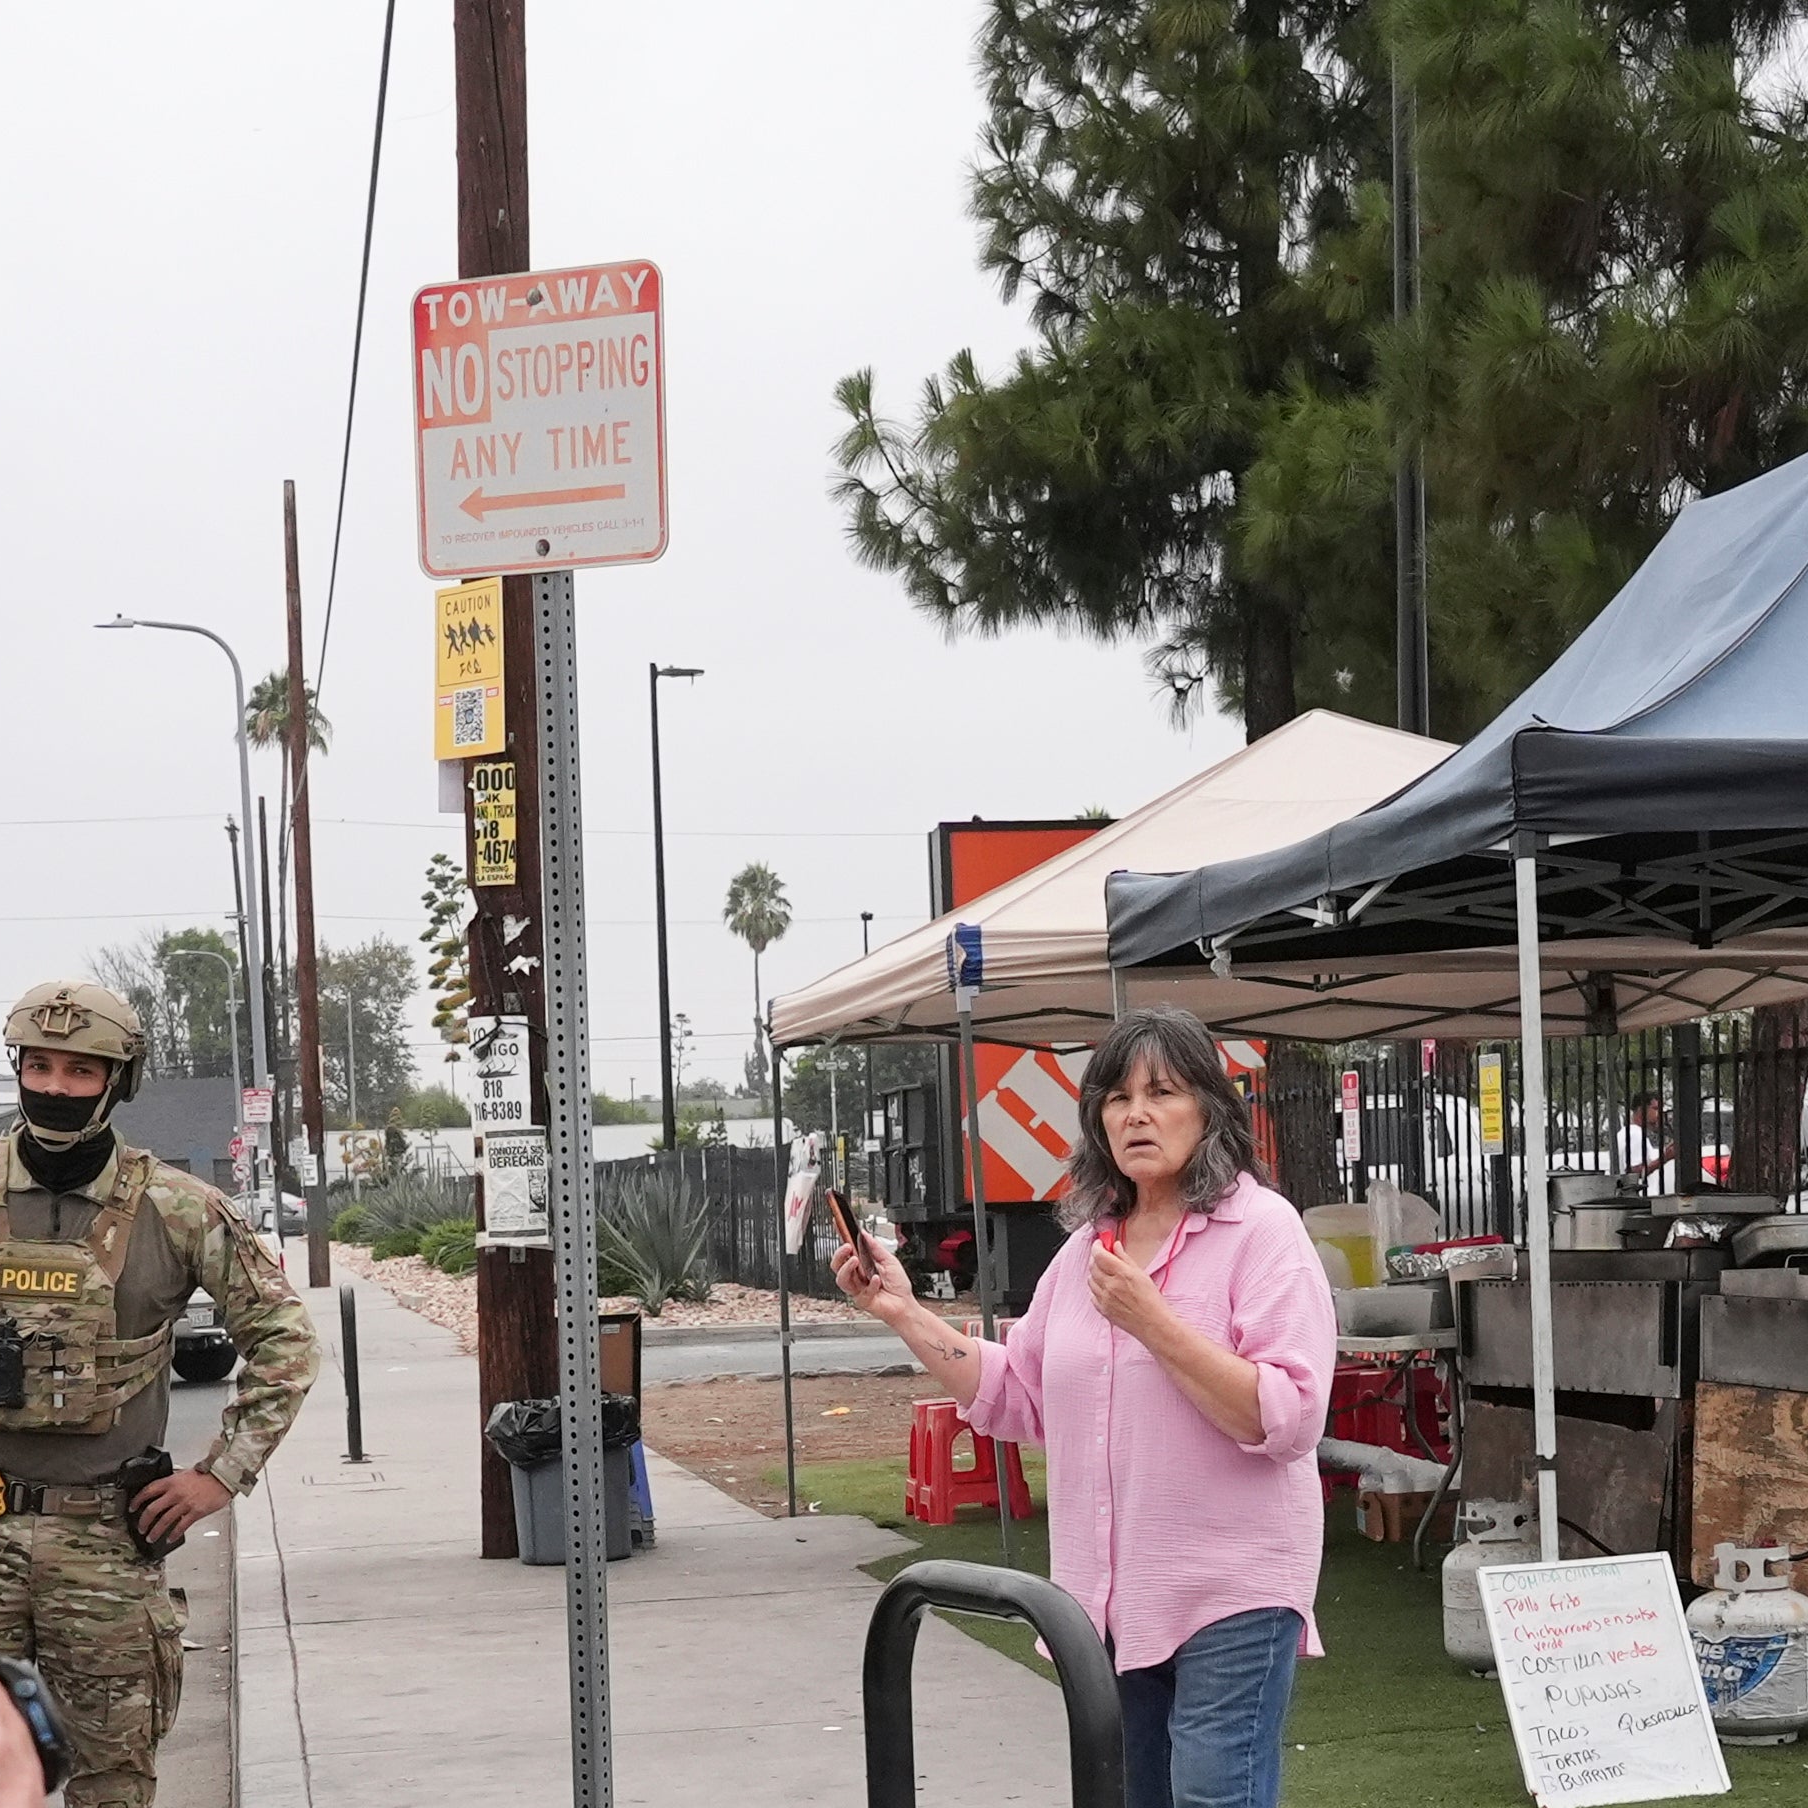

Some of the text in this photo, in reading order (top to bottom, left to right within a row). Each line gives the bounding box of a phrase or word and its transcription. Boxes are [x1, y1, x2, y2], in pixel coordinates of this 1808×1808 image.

[421, 269, 649, 331] TOW-AWAY
[421, 334, 649, 420] NO STOPPING
[450, 421, 632, 480] ANY TIME
[455, 532, 495, 543] RECOVER
[498, 527, 549, 540] IMPOUNDED
[552, 522, 593, 535] VEHICLES
[597, 520, 619, 531] CALL
[445, 594, 491, 616] CAUTION
[474, 840, 516, 864] -4674
[487, 873, 515, 882] ESPAÑO
[483, 1079, 503, 1099] 818
[488, 1146, 528, 1157] CONOZCA
[489, 1156, 545, 1168] DERECHOS
[1, 1268, 79, 1292] POLICE
[1502, 1569, 1561, 1592] COMIDA
[1503, 1596, 1539, 1619] Pollo
[1545, 1680, 1642, 1714] PUPUSAS
[1537, 1749, 1601, 1772] TORTAS
[1558, 1762, 1626, 1791] BURRITOS
